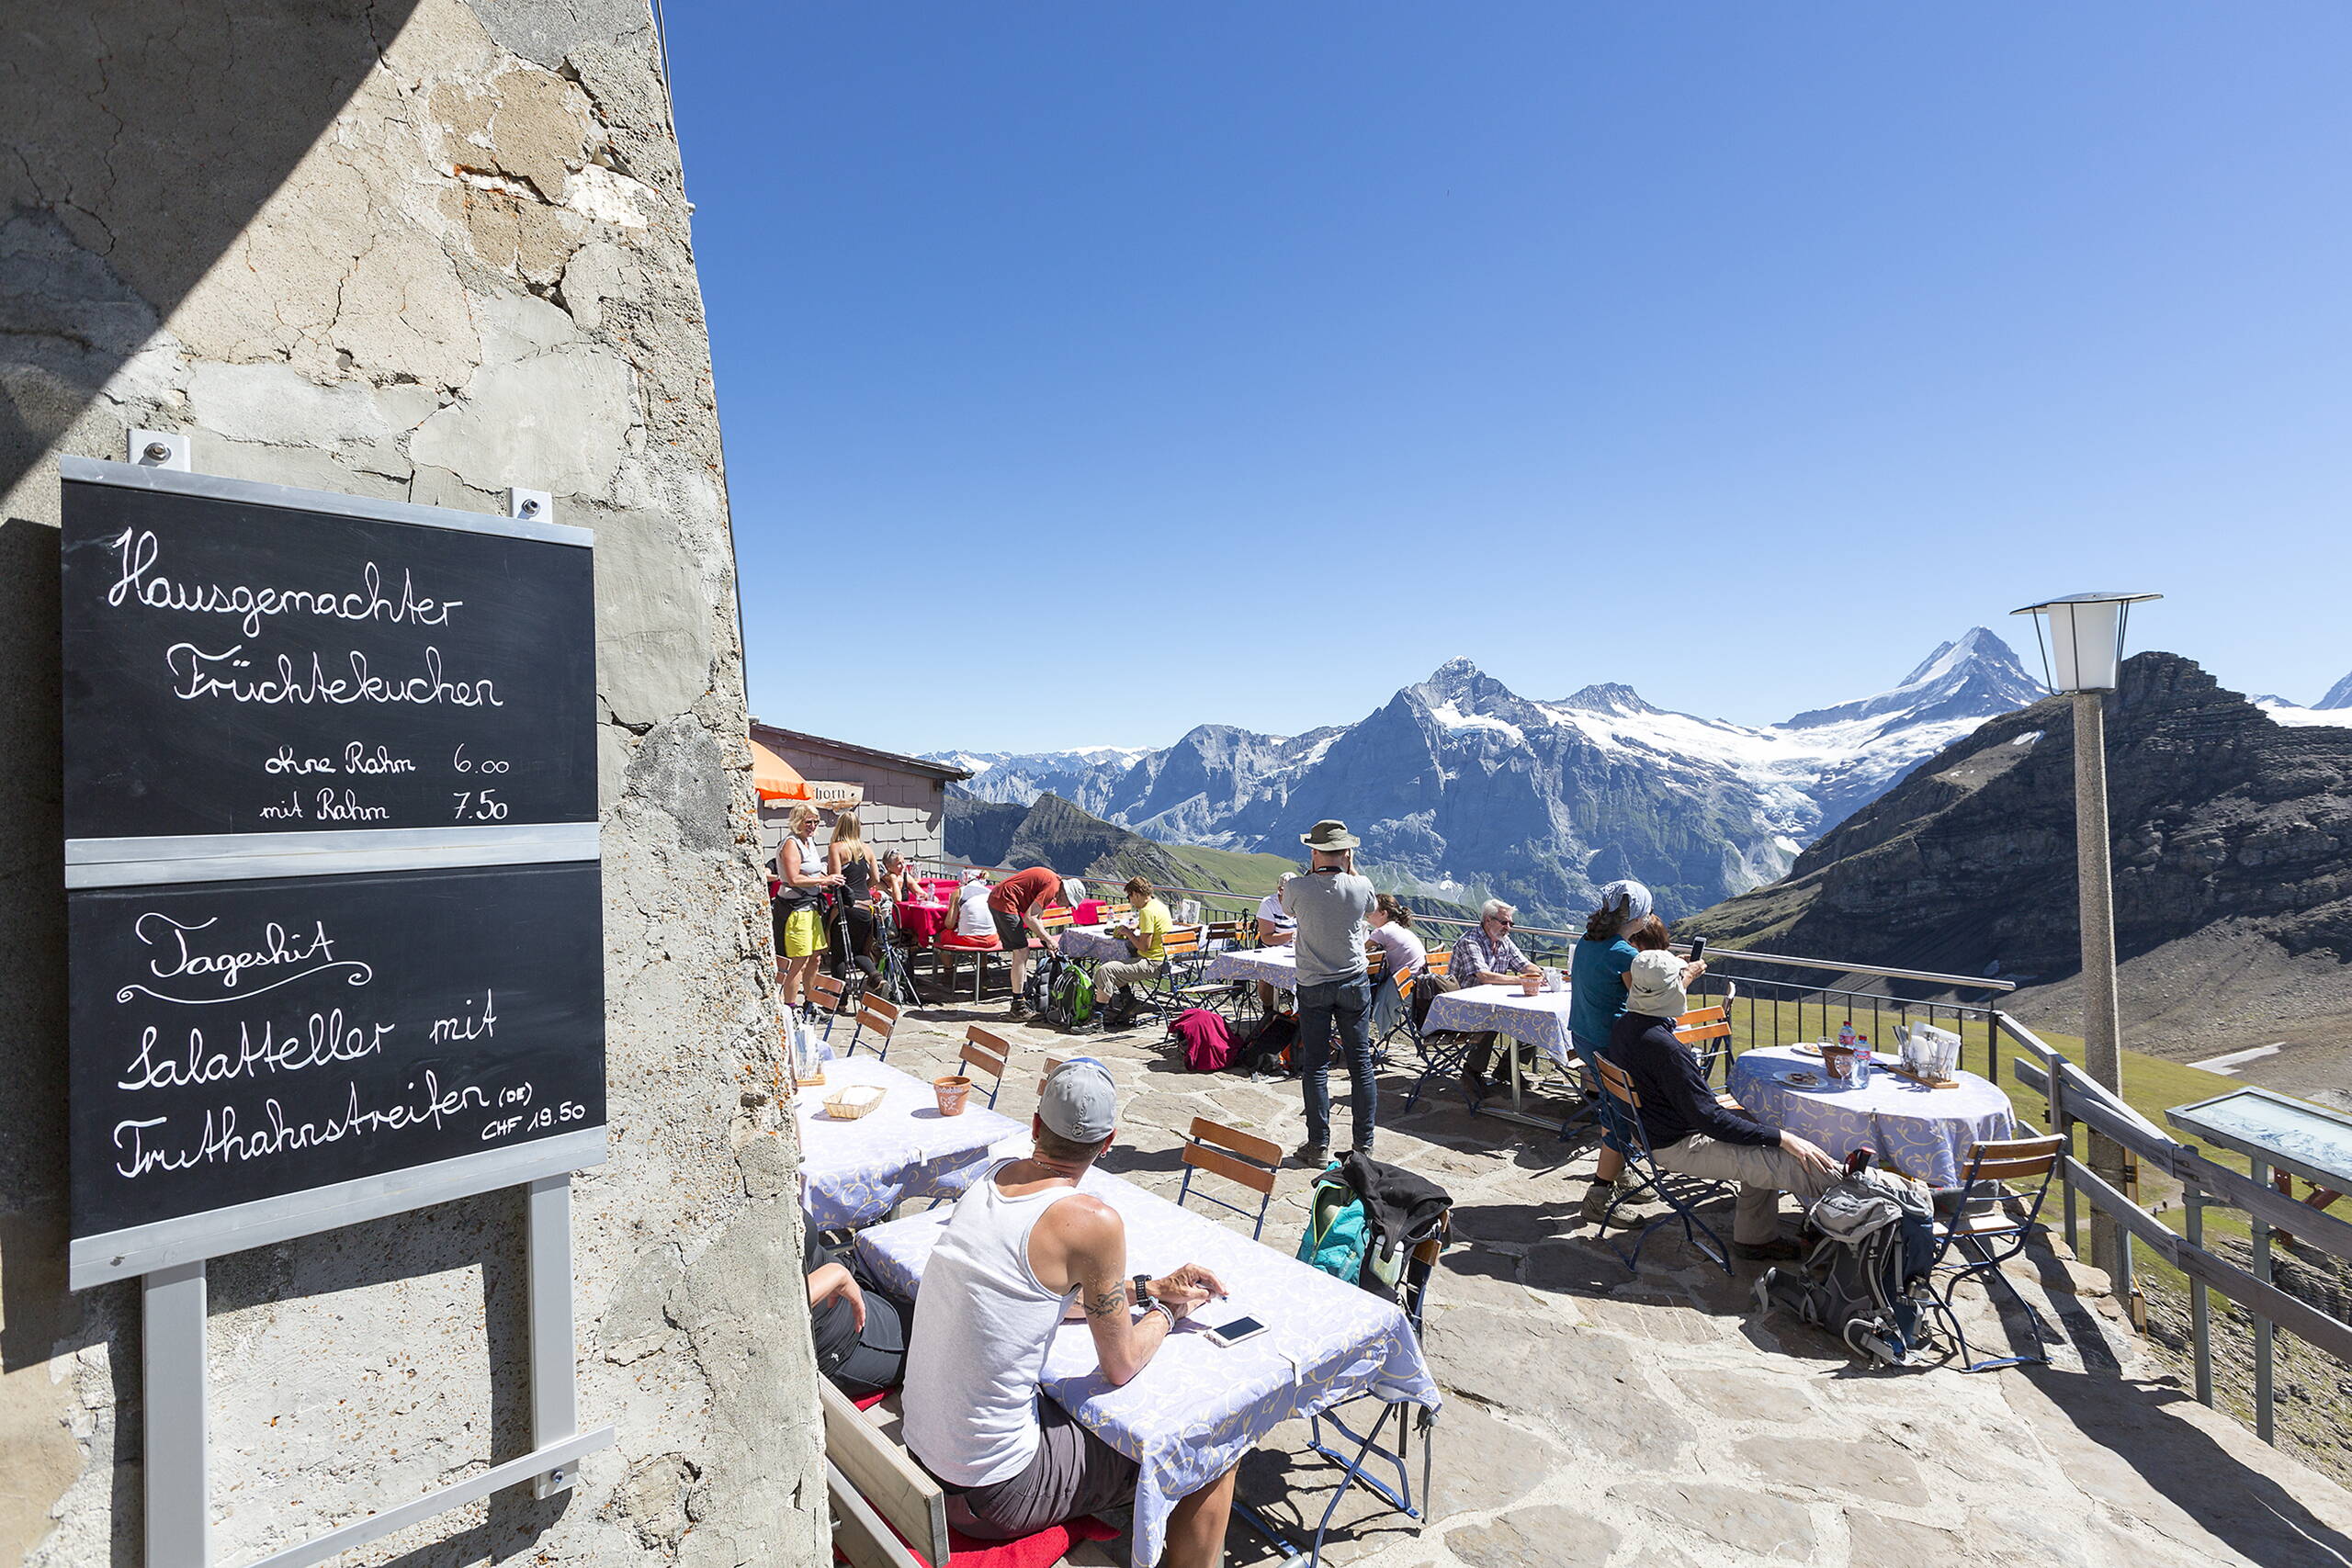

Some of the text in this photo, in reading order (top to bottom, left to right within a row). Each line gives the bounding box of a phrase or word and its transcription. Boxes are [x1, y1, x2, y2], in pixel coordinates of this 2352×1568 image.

[107, 526, 463, 637] Hausgemachter
[166, 643, 504, 707] Früchtekuchen
[265, 741, 510, 775] ohne Rahm 6.00
[259, 787, 508, 820] mit Rahm 7.50
[135, 912, 334, 987] Tageshit
[118, 987, 497, 1091] Salatteller mit
[114, 1069, 490, 1179] Truthahnstreifen
[481, 1100, 586, 1141] CHF 19.50
